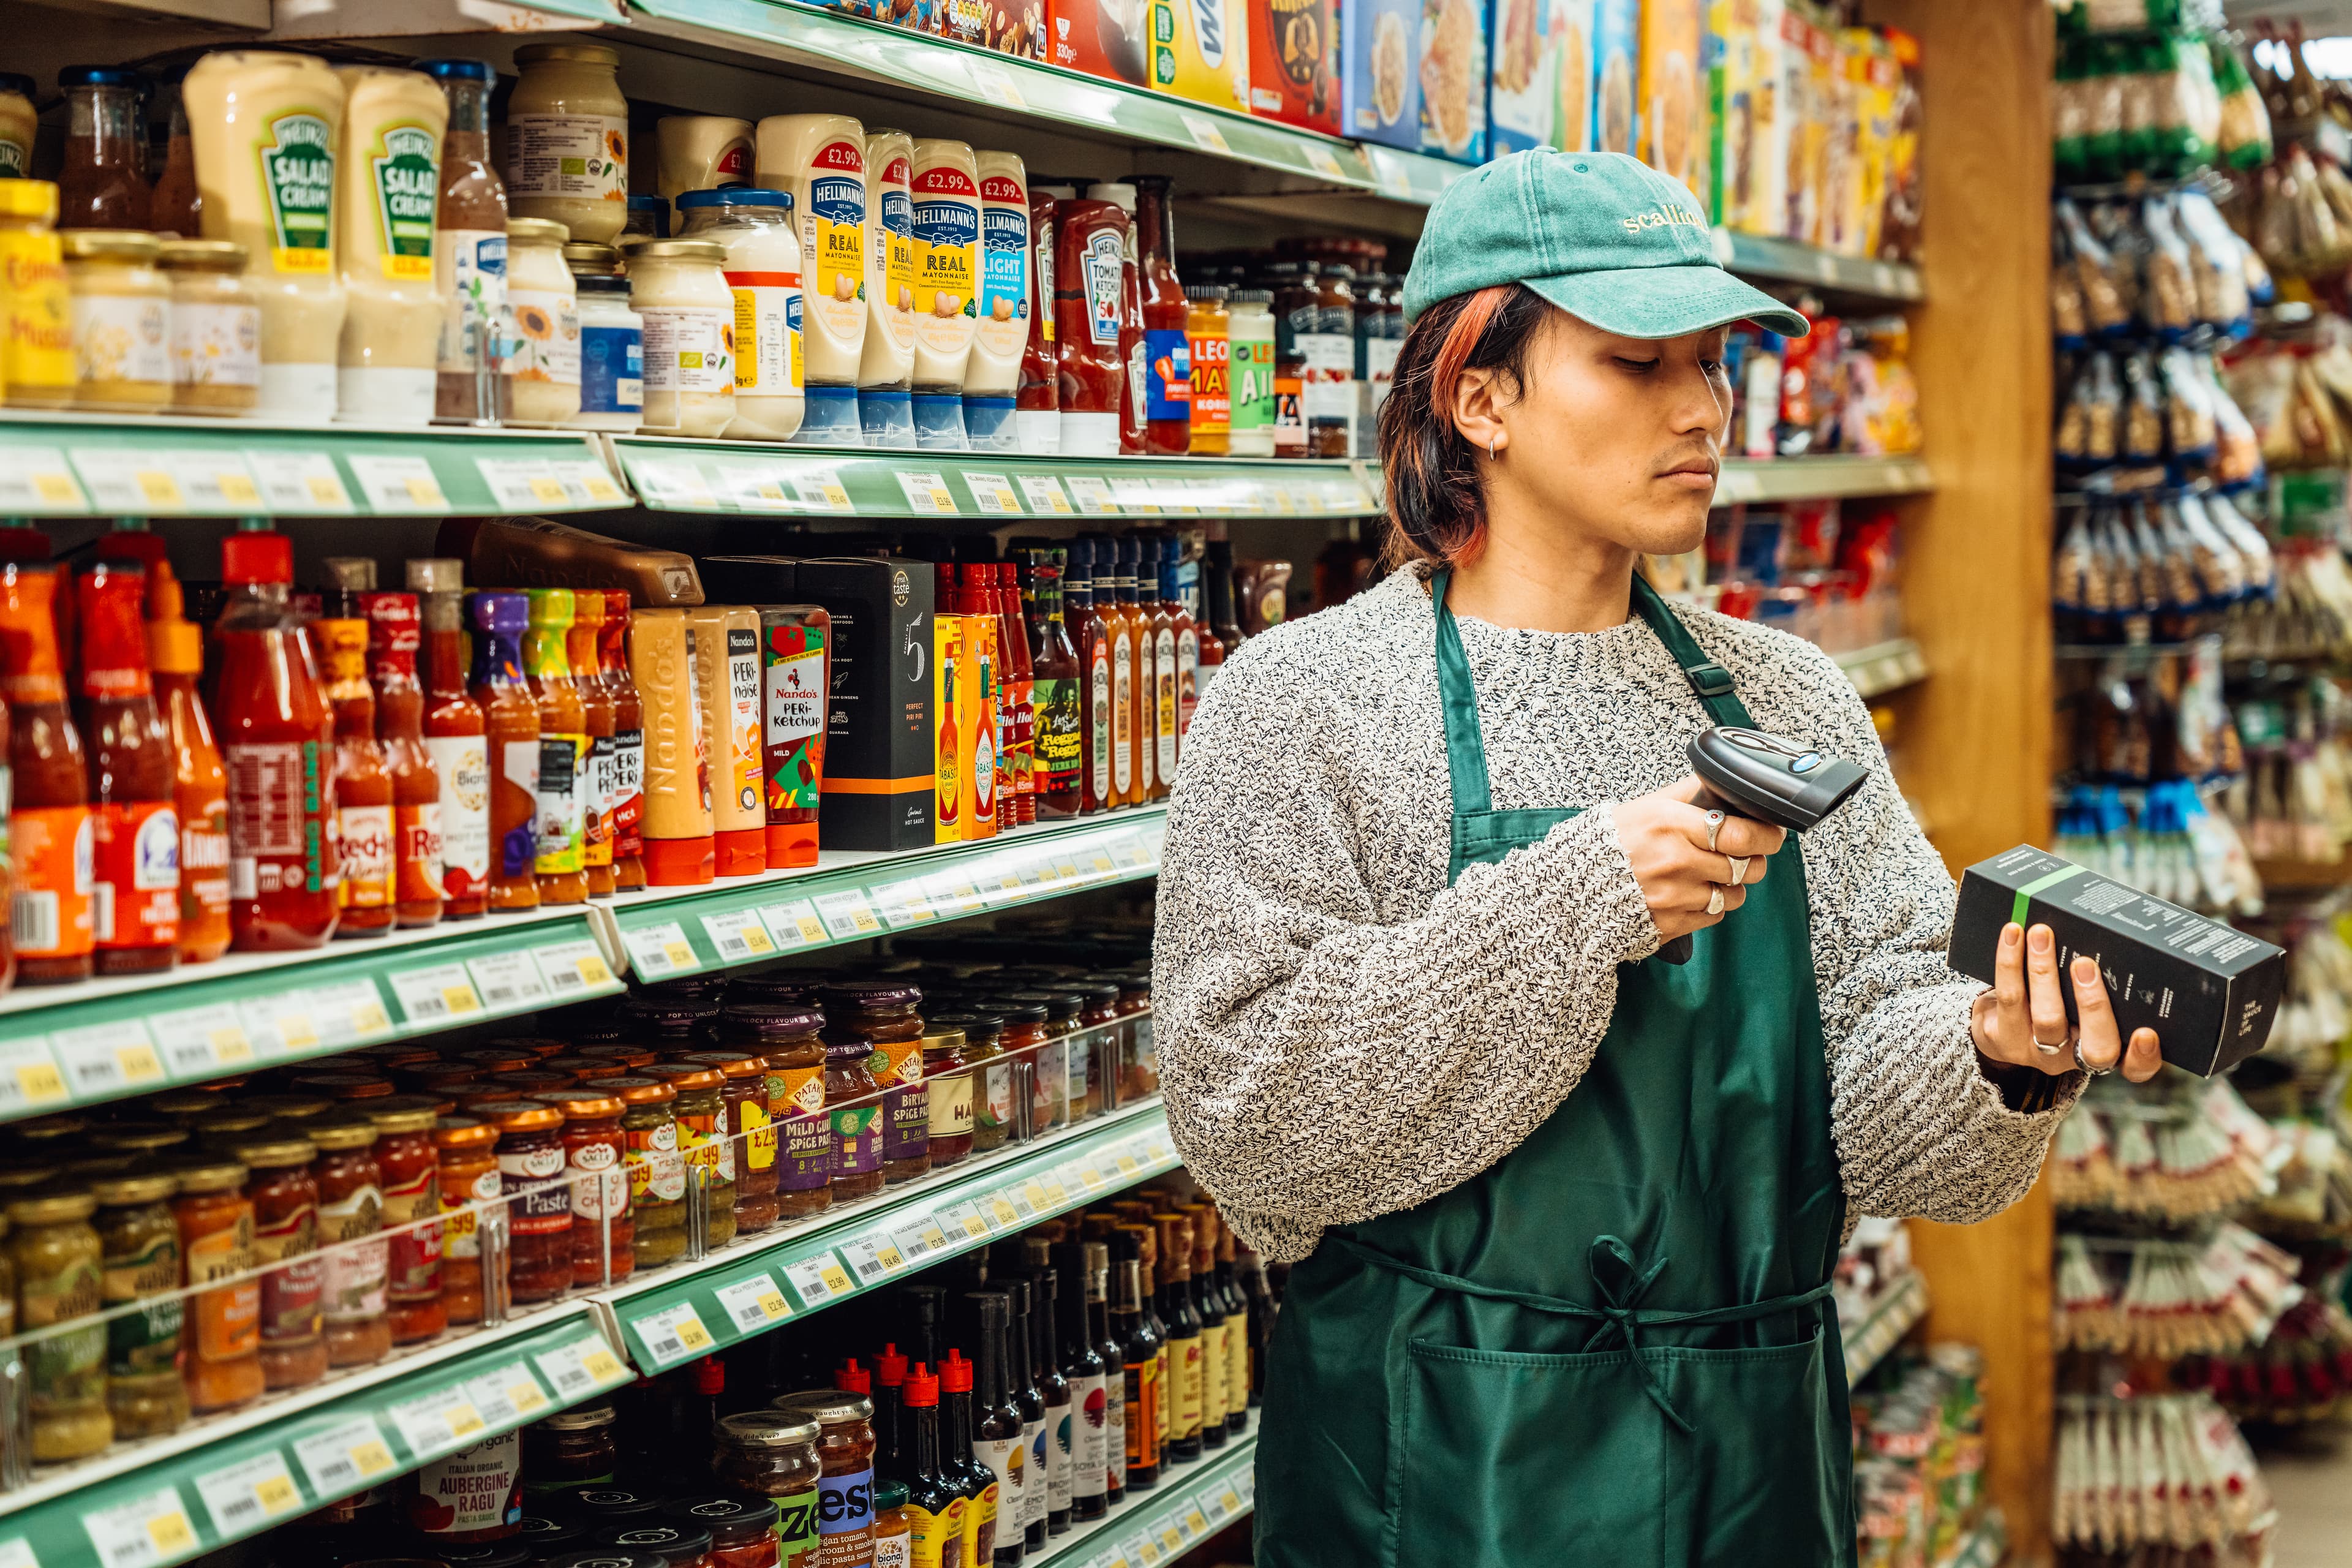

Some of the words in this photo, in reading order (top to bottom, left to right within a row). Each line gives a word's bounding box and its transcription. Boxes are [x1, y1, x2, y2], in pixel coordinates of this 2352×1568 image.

[828, 148, 856, 165] £2.99
[274, 157, 330, 185] SALAD
[385, 167, 435, 195] SALAD
[927, 174, 963, 189] £2.99
[281, 186, 328, 208] CREAM
[816, 185, 864, 208] HELLMANN'S
[986, 182, 1016, 198] £2.99
[390, 194, 432, 217] CREAM
[913, 209, 975, 230] HELLMANN'S
[829, 234, 859, 252] REAL
[826, 252, 861, 261] MAYONNAISE
[894, 246, 913, 265] REAL
[927, 255, 966, 271] REAL
[984, 257, 1020, 274] LIGHT
[937, 497, 951, 507] £3.99
[894, 584, 910, 595] taste
[730, 635, 754, 647] Nando's
[952, 620, 961, 680] FIERY
[735, 683, 758, 698] naise
[775, 688, 817, 699] Nando's
[784, 701, 812, 716] PERi-
[774, 715, 820, 729] Ketchup
[2242, 1005, 2262, 1020] SAUCE
[2244, 1000, 2256, 1010] THE
[903, 1130, 908, 1139] 8
[799, 1161, 805, 1170] 8
[526, 1192, 569, 1215] Paste
[970, 1223, 985, 1234] £4.00
[931, 1237, 946, 1249] £2.99
[884, 1255, 900, 1267] £4.49
[829, 1276, 845, 1289] £2.99
[768, 1299, 786, 1311] £2.99
[448, 1464, 475, 1474] ITALIAN
[477, 1461, 503, 1472] ORGANIC
[439, 1472, 510, 1495] AUBERGINE
[459, 1493, 495, 1512] RAGU
[458, 1514, 477, 1523] PASTA
[841, 1532, 868, 1544] tomato,
[854, 1538, 875, 1550] smoked
[832, 1556, 856, 1566] pasta
[856, 1549, 873, 1559] sauce
[877, 1553, 900, 1562] biona
